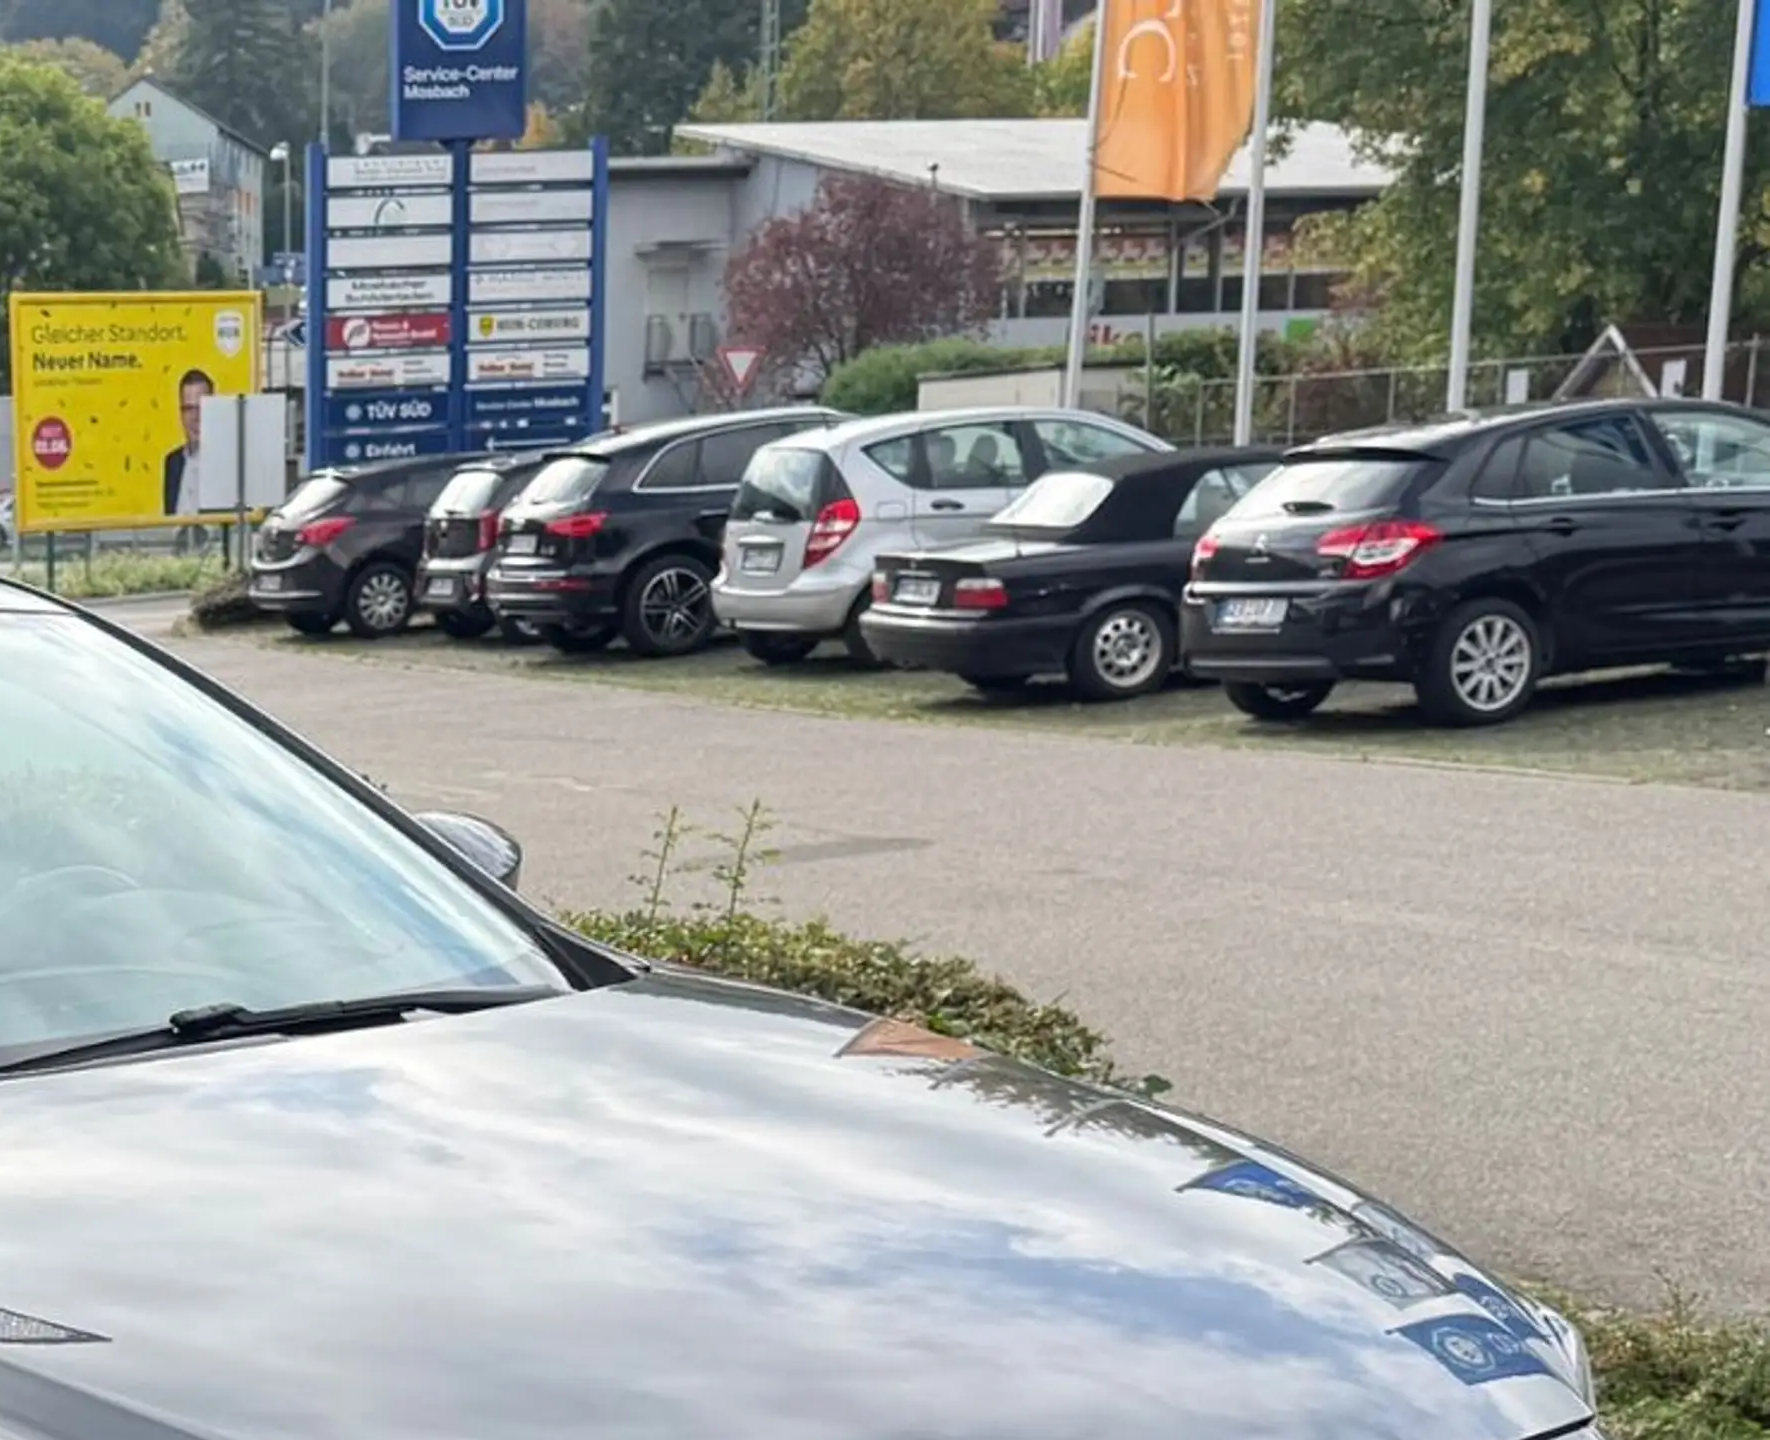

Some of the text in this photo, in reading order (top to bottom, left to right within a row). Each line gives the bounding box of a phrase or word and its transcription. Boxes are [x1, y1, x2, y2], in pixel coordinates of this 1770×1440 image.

[403, 64, 519, 83] Service-Center
[403, 84, 470, 99] Mosbach
[32, 320, 188, 344] Gleicher Standort.
[32, 350, 143, 371] Neuer Name.
[366, 398, 432, 420] TÜV SÜD
[365, 443, 416, 458] Einfahrt
